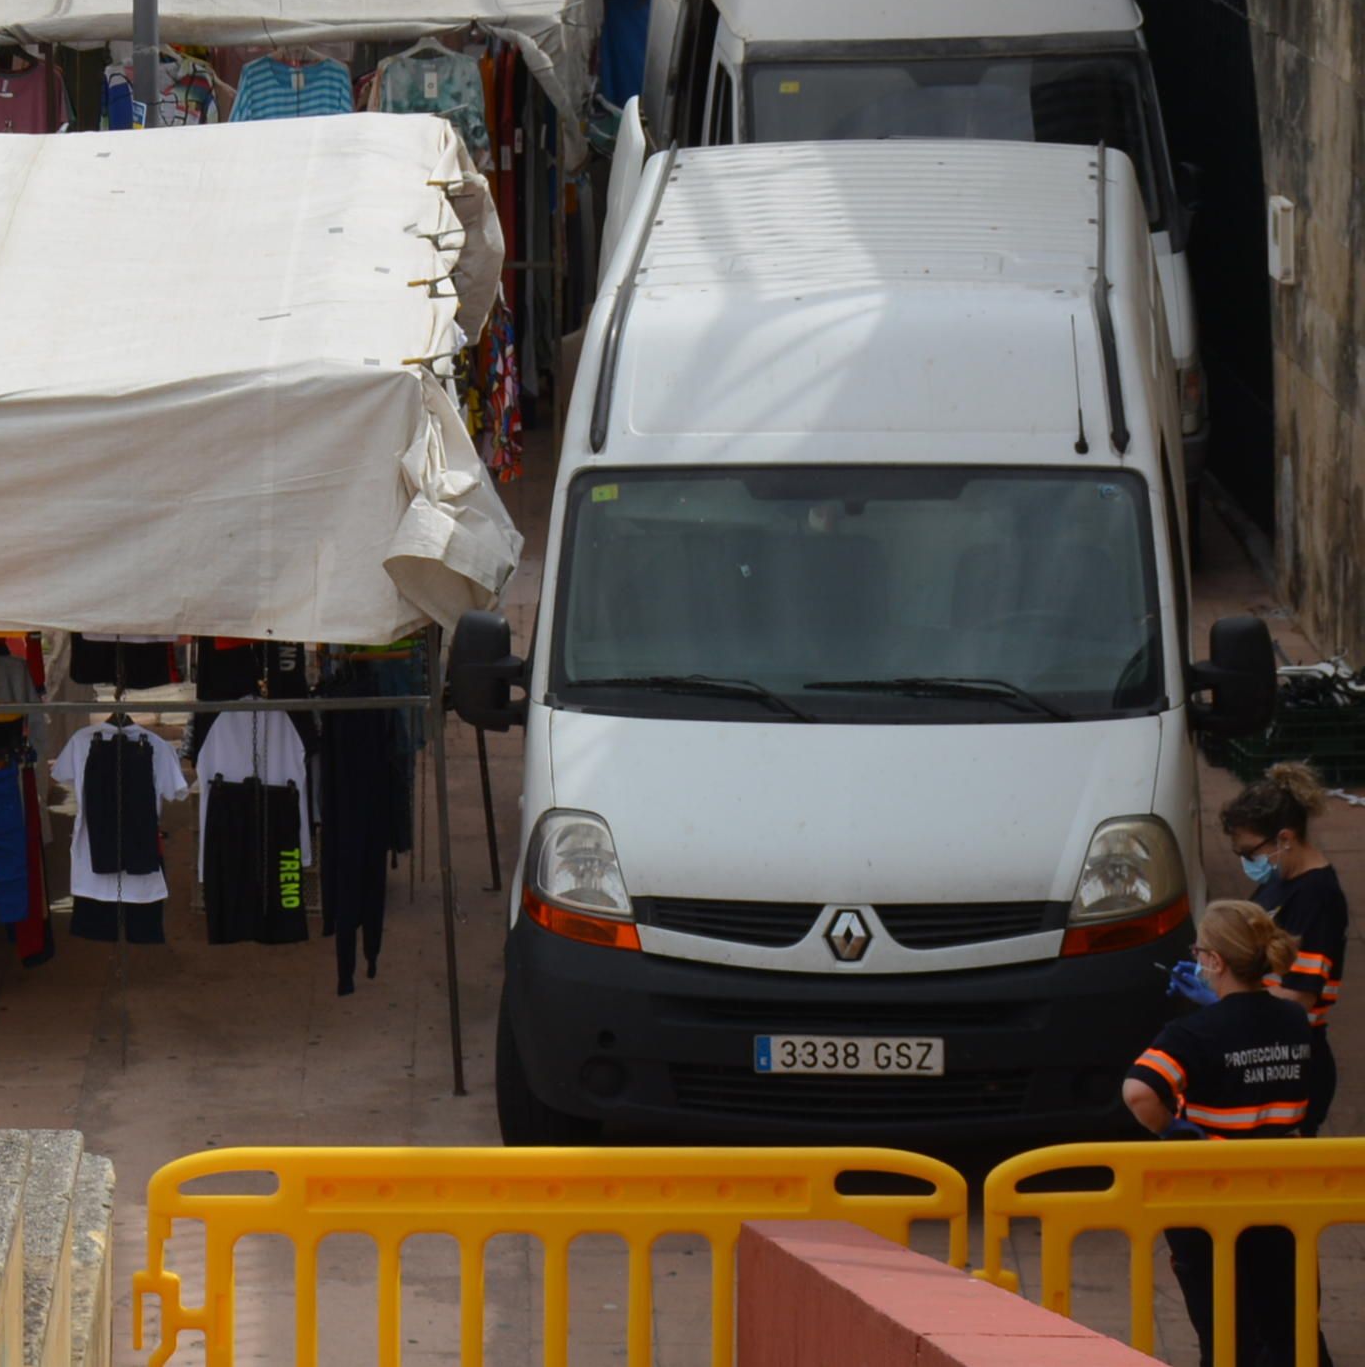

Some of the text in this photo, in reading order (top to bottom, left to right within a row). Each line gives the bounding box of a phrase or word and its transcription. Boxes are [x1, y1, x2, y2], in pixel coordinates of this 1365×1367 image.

[279, 848, 301, 909] TREND
[780, 1040, 860, 1069] 3338
[874, 1042, 934, 1070] GSZ
[1243, 1068, 1264, 1083] SAN
